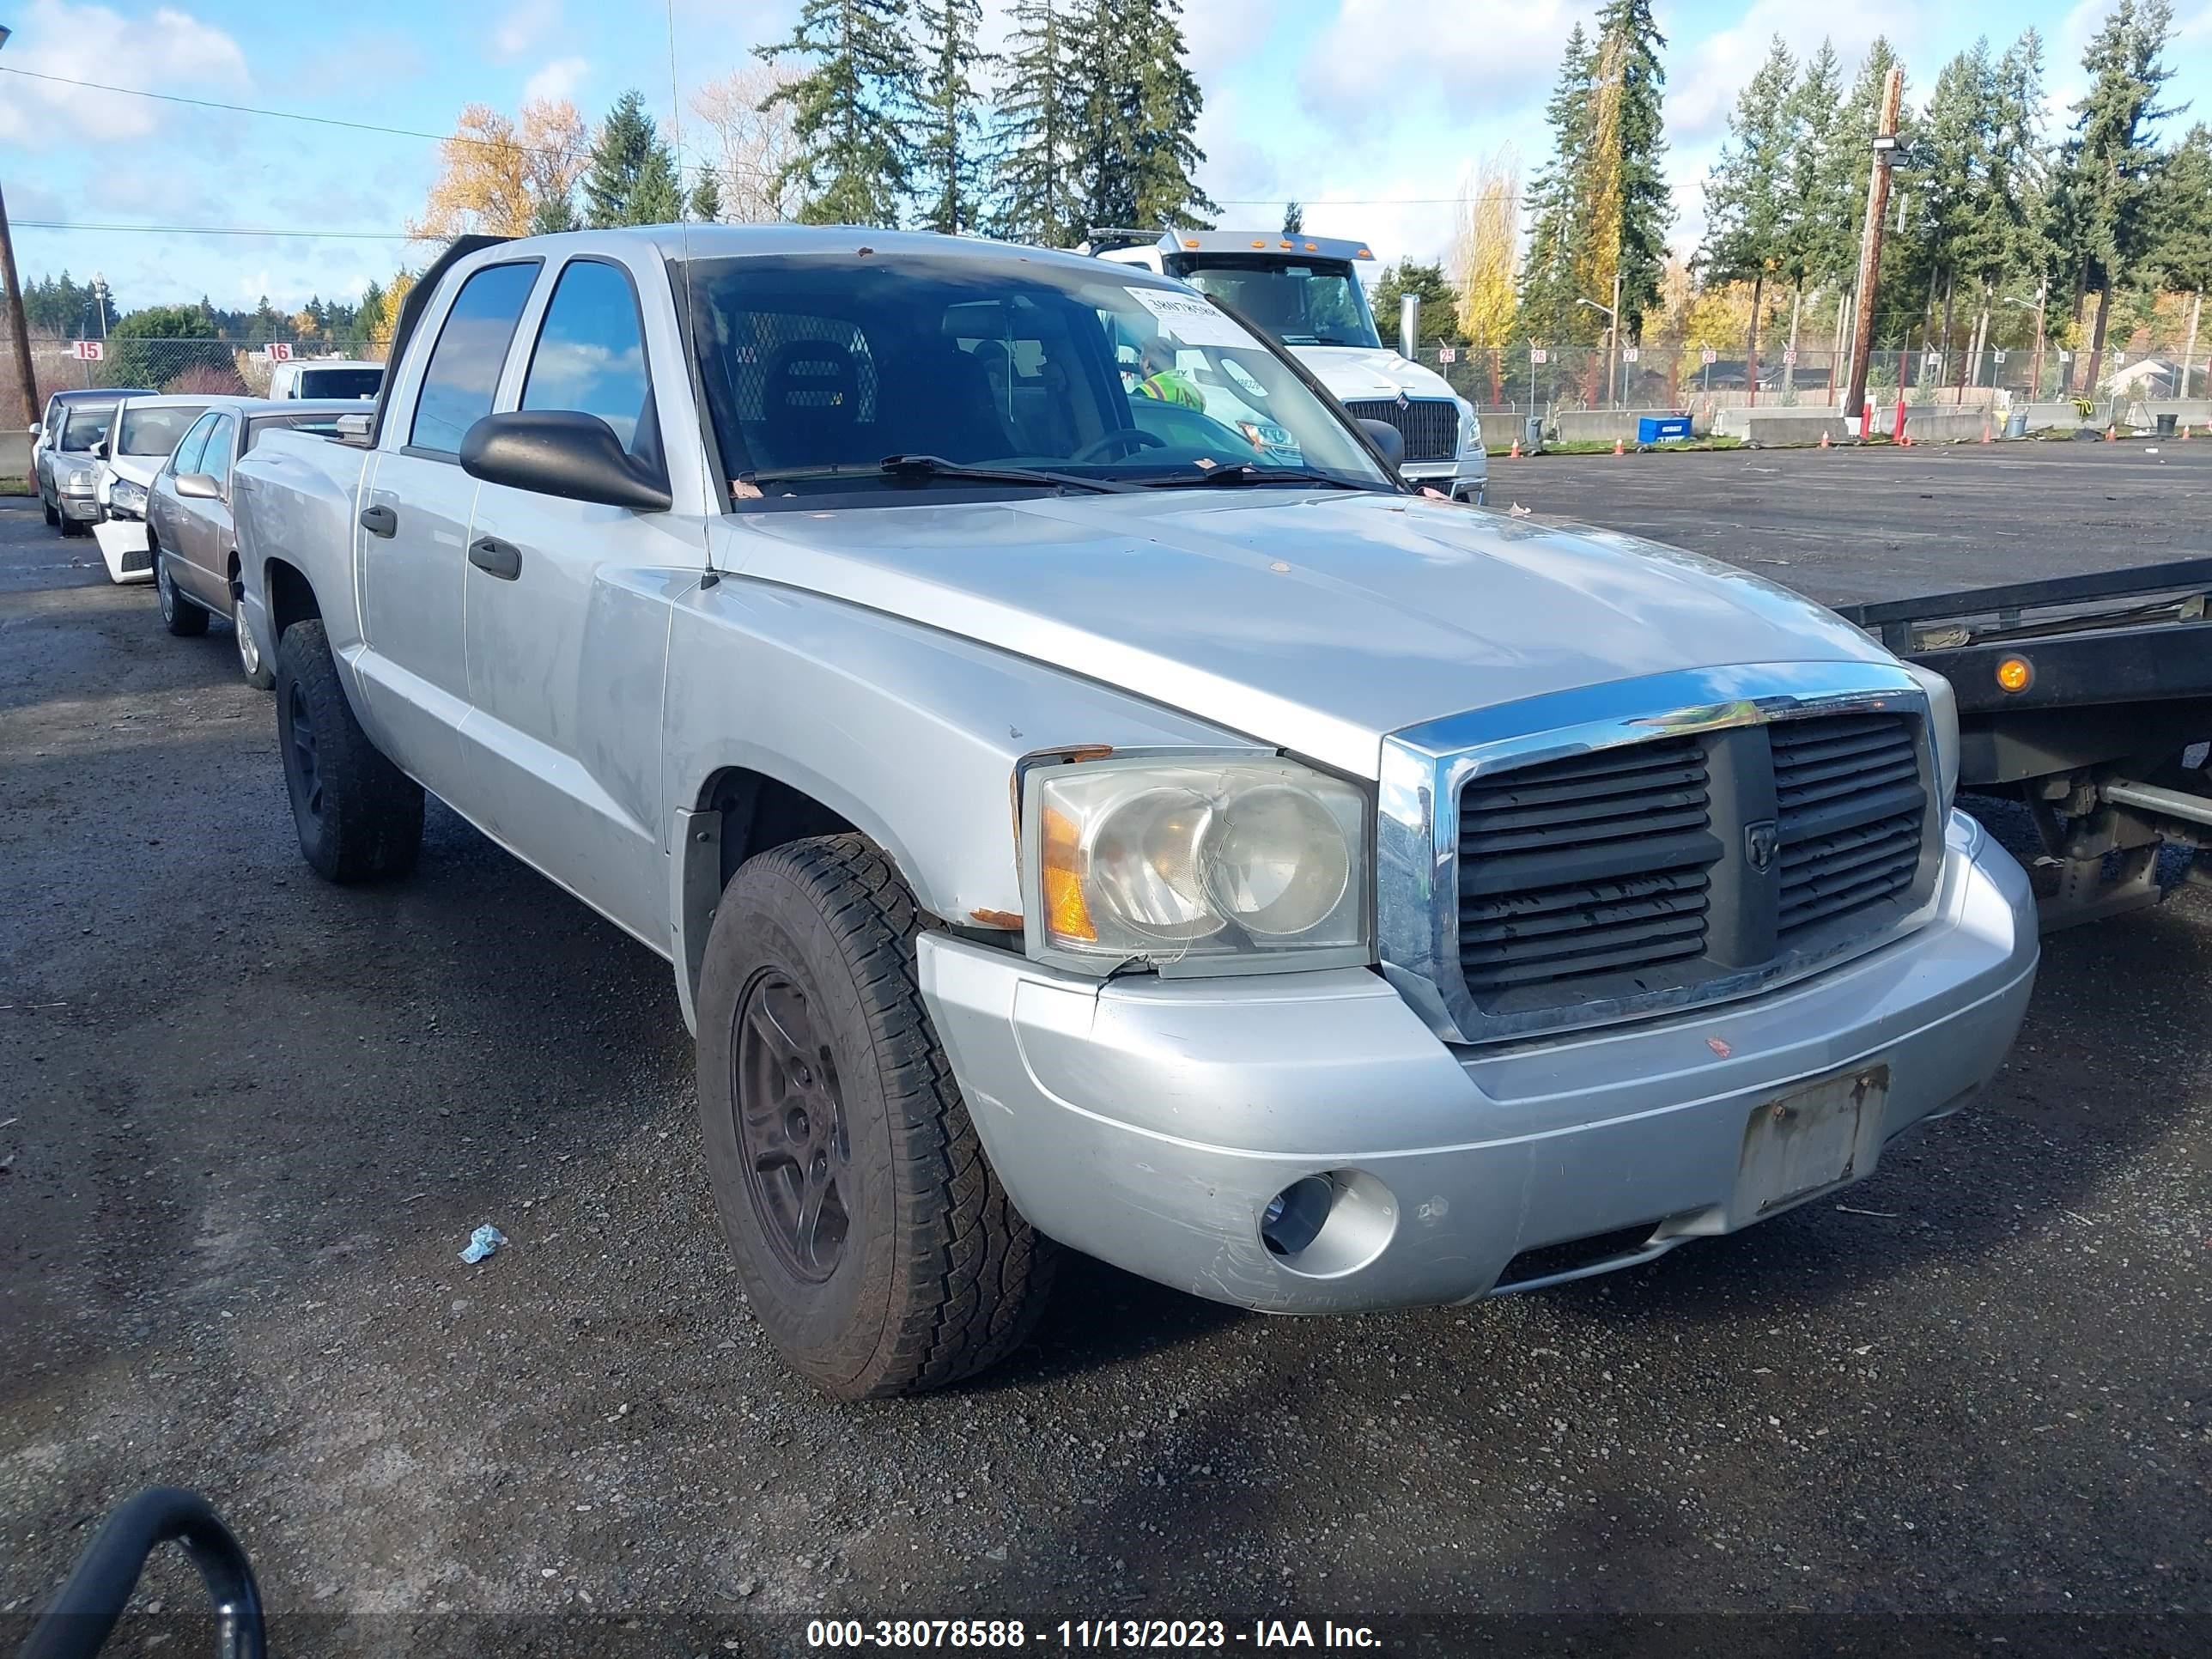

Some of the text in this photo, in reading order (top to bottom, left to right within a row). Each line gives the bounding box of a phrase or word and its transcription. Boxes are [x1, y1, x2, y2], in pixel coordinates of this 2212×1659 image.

[78, 342, 99, 359] 15
[269, 344, 289, 360] 16
[1442, 350, 1454, 362] 25
[1532, 350, 1545, 362] 26
[1625, 349, 1636, 361] 27
[1704, 350, 1715, 362] 28
[1784, 351, 1796, 362] 29
